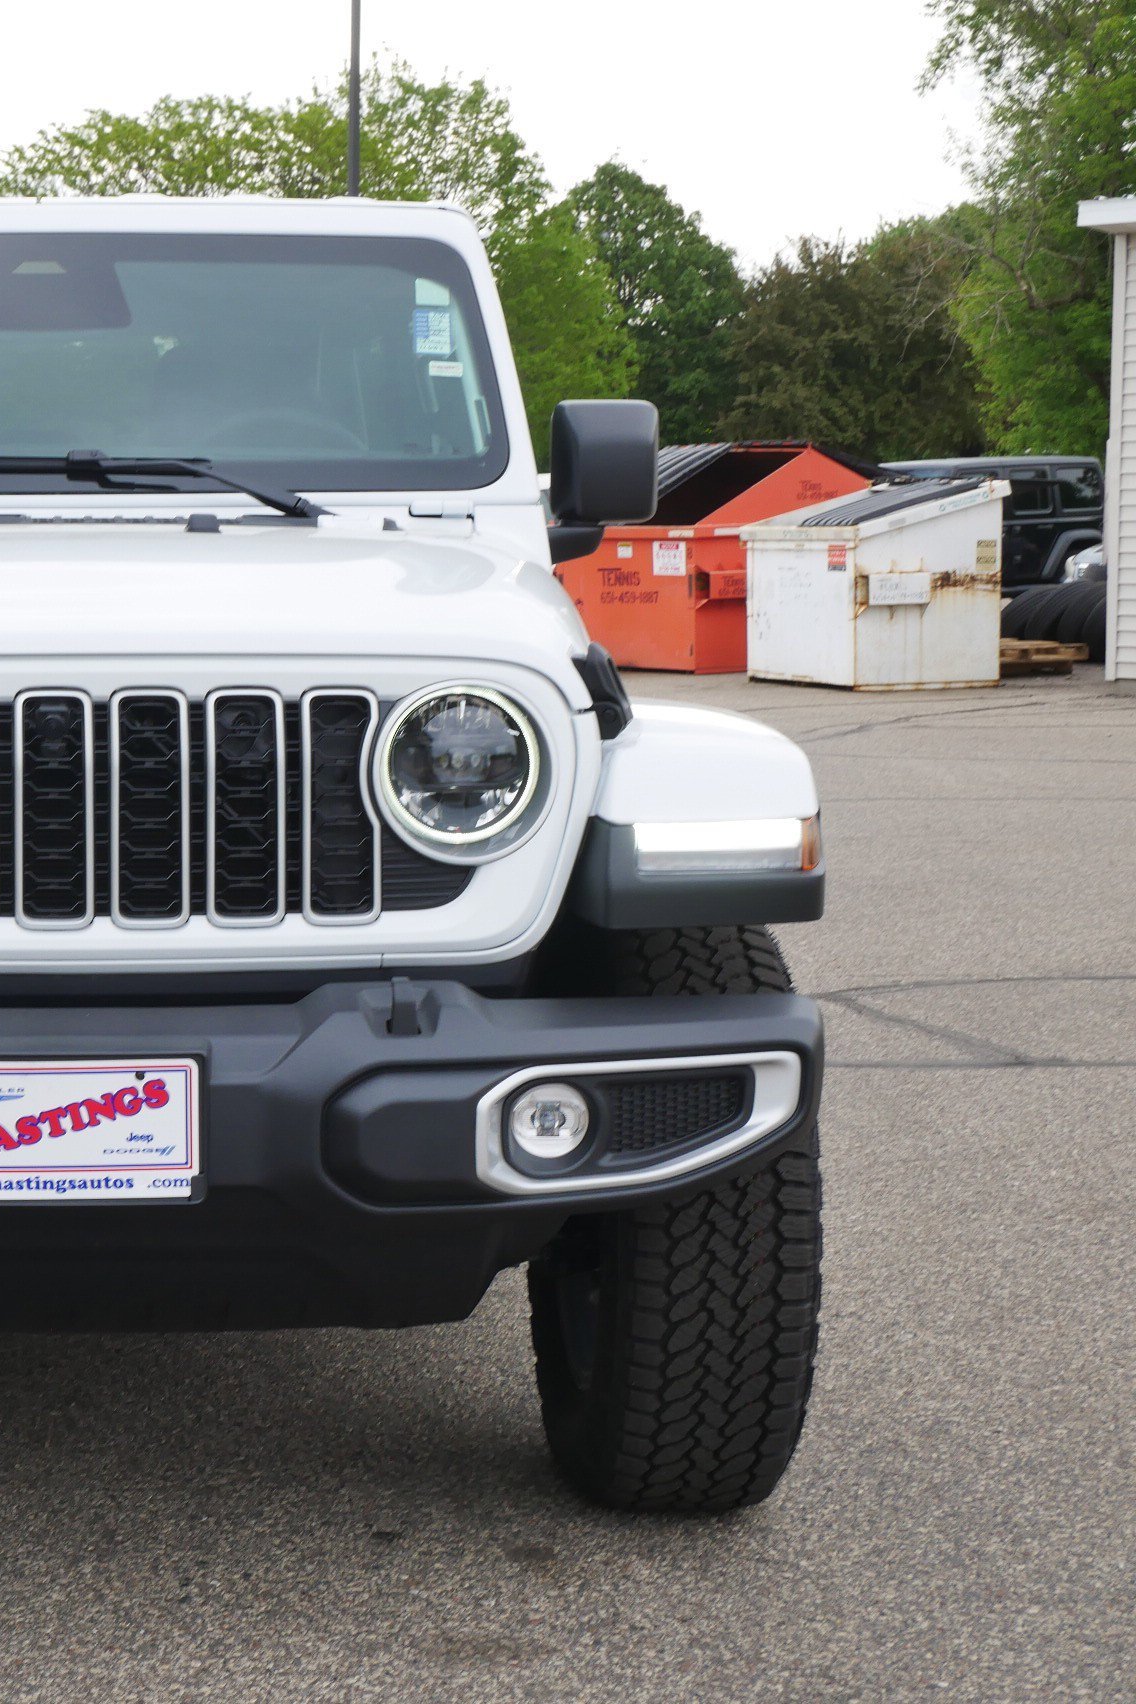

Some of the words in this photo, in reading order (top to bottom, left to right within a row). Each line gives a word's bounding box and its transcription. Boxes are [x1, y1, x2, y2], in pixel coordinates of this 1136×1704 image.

[597, 568, 641, 587] TENNIS
[600, 590, 659, 604] 651-459-1887
[126, 1132, 154, 1143] Jeep
[103, 1146, 164, 1154] DODGE
[146, 1178, 192, 1188] .com
